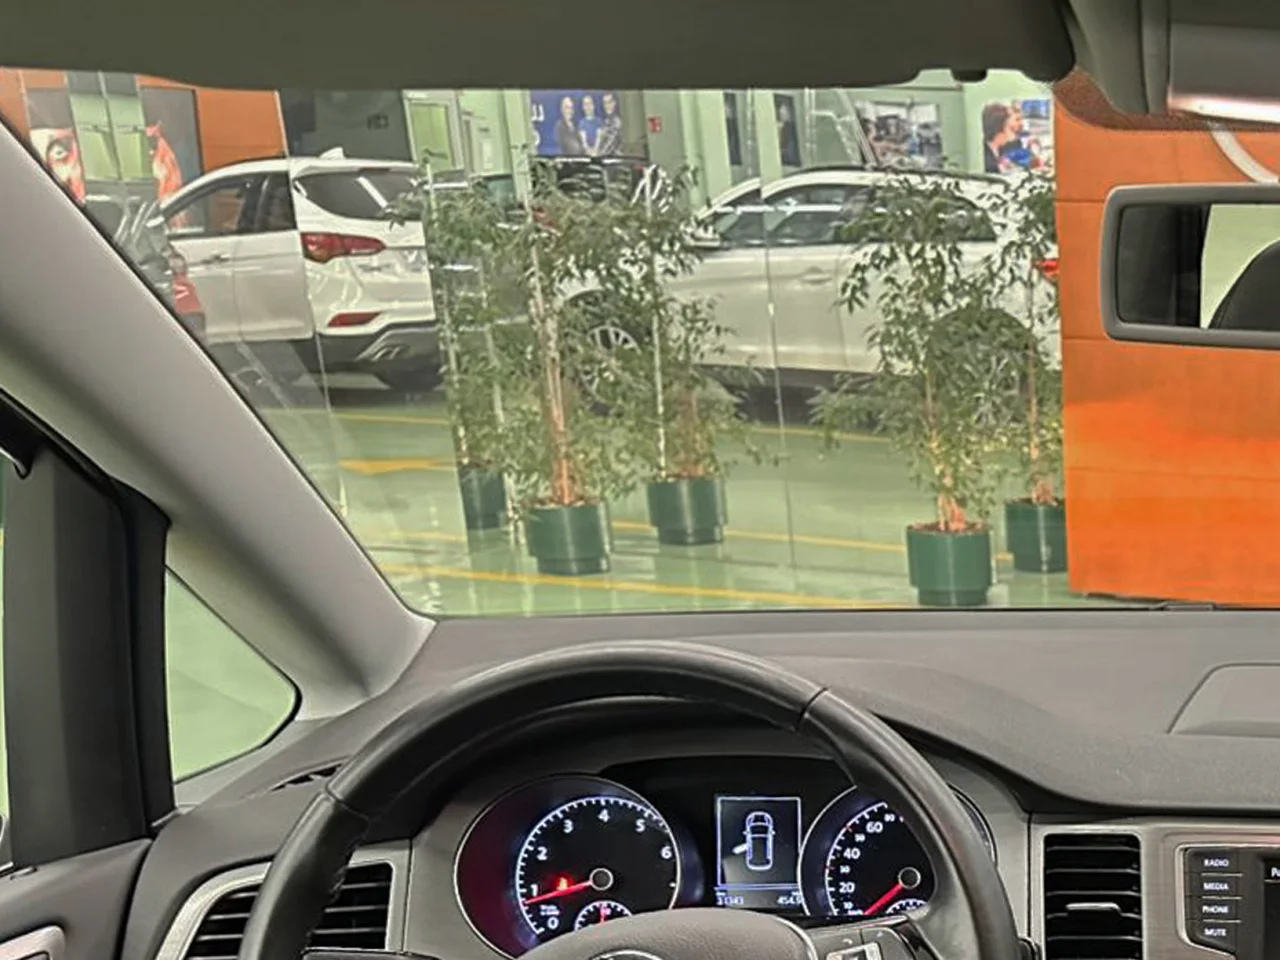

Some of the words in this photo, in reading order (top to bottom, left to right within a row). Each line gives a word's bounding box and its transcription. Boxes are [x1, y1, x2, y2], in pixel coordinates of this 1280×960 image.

[598, 809, 610, 822] 4
[563, 819, 574, 833] 3
[635, 819, 646, 832] 5
[865, 821, 884, 833] 60
[536, 846, 548, 860] 2
[660, 846, 672, 859] 6
[843, 847, 861, 859] 40
[1203, 858, 1230, 867] RADIO
[530, 884, 539, 896] 1
[839, 881, 855, 893] 20
[1203, 882, 1229, 890] MEDIA
[1202, 905, 1229, 914] PHONE
[547, 917, 559, 929] 0
[1204, 928, 1227, 937] MUTE
